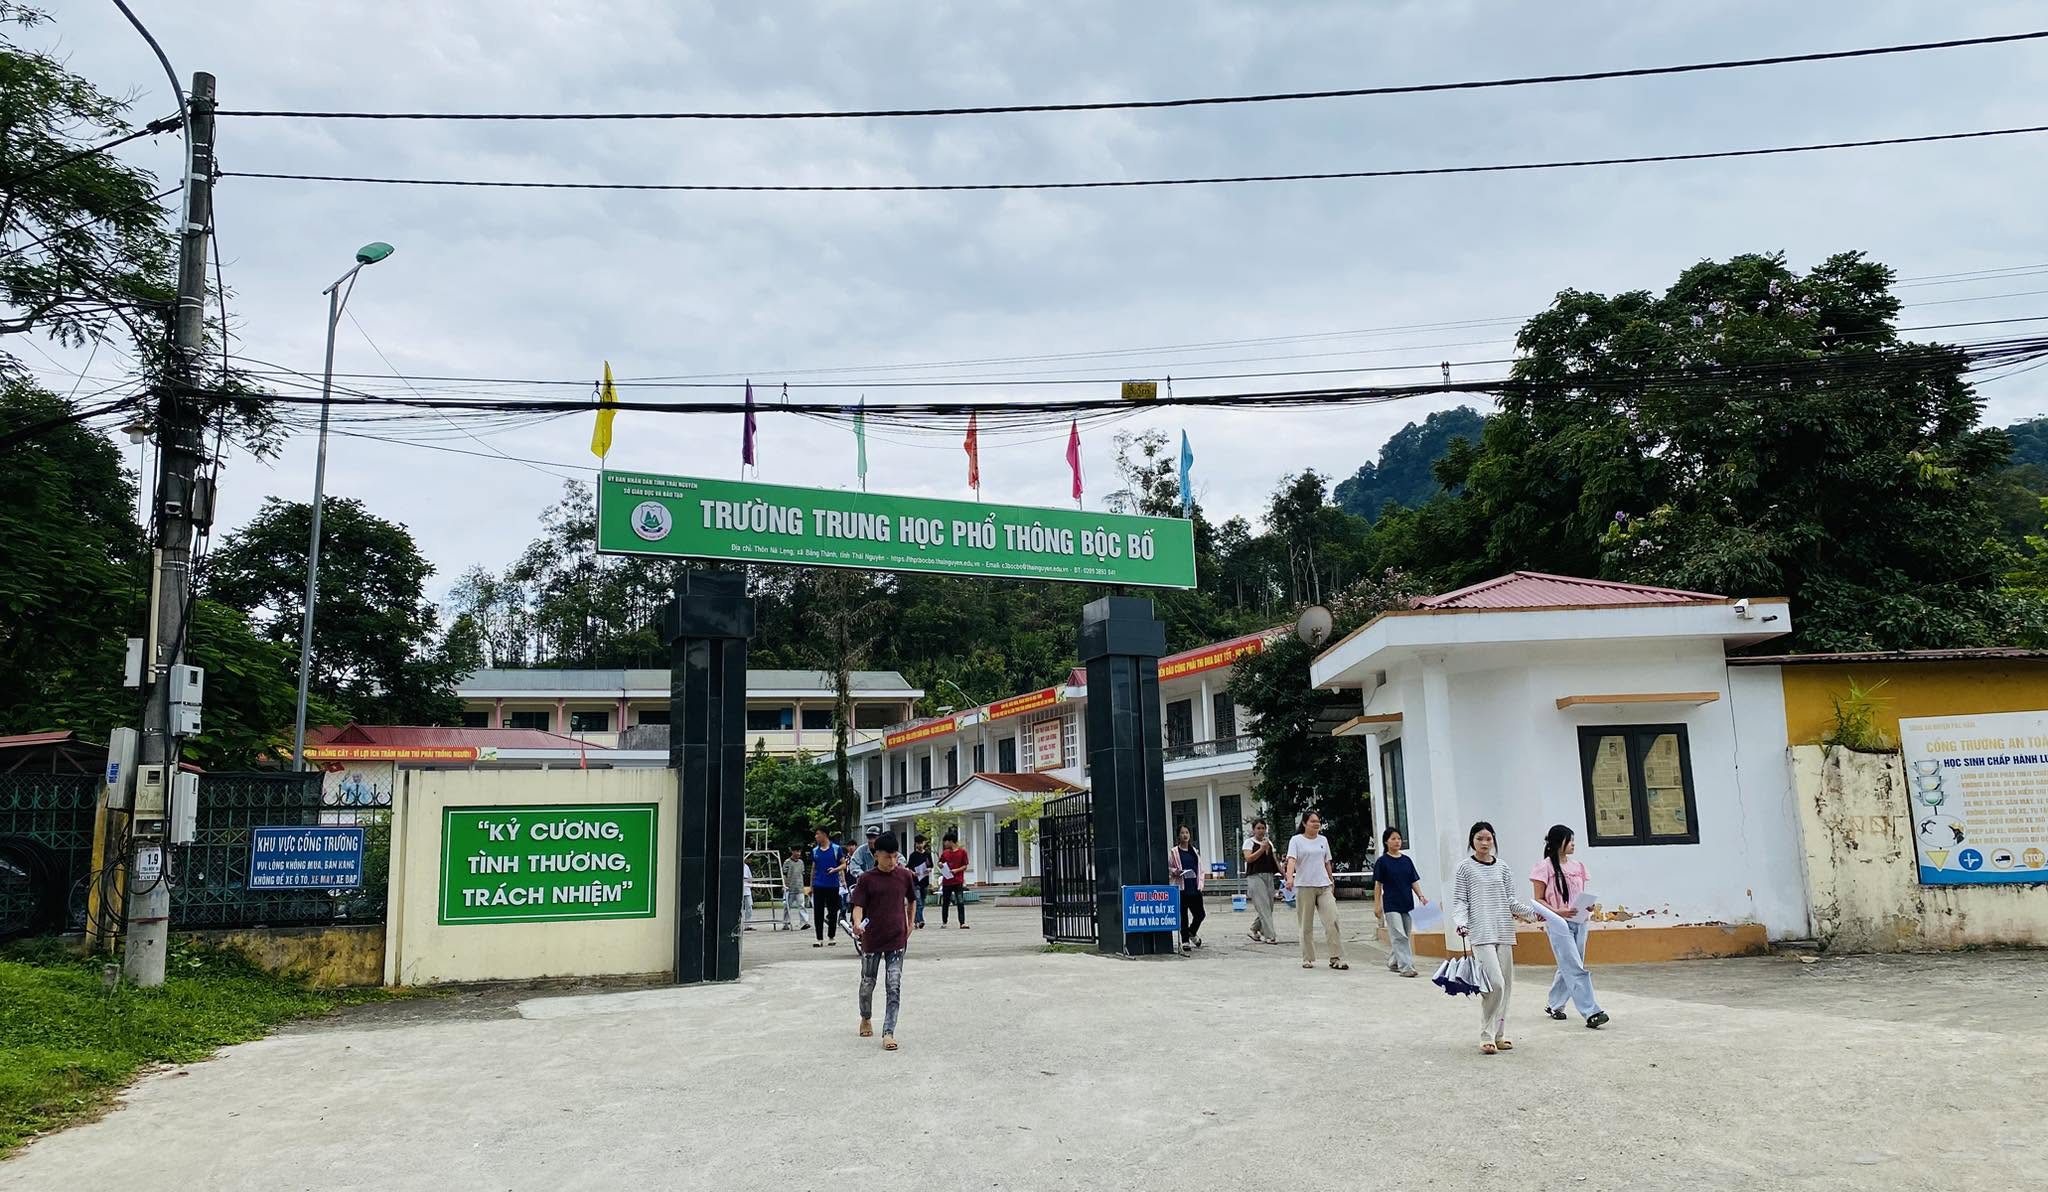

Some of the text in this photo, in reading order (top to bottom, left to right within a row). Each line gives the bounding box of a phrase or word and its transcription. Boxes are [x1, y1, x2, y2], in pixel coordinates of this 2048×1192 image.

[700, 497, 1155, 562] TRƯỜNG TRUNG HỌC PHỔ THÔNG BỘC BỐ
[1943, 758, 1962, 769] HỌC
[1963, 757, 1985, 767] SINH
[1987, 753, 2011, 766] CHẤP
[2013, 754, 2038, 764] HÀNH
[530, 820, 625, 843] CƯƠNG,
[257, 831, 359, 856] KHU VỰC CỔNG TRƯỜNG
[268, 858, 285, 871] LÒNG
[286, 858, 306, 870] KHÔNG
[468, 850, 632, 874] TÌNH THƯƠNG,
[253, 873, 275, 886] KHÔNG
[285, 875, 293, 885] XE
[462, 883, 545, 907] TRÁCH
[1167, 905, 1175, 914] XE
[1127, 917, 1138, 927] KHI
[1138, 917, 1147, 927] RA
[1147, 915, 1160, 926] VÀO
